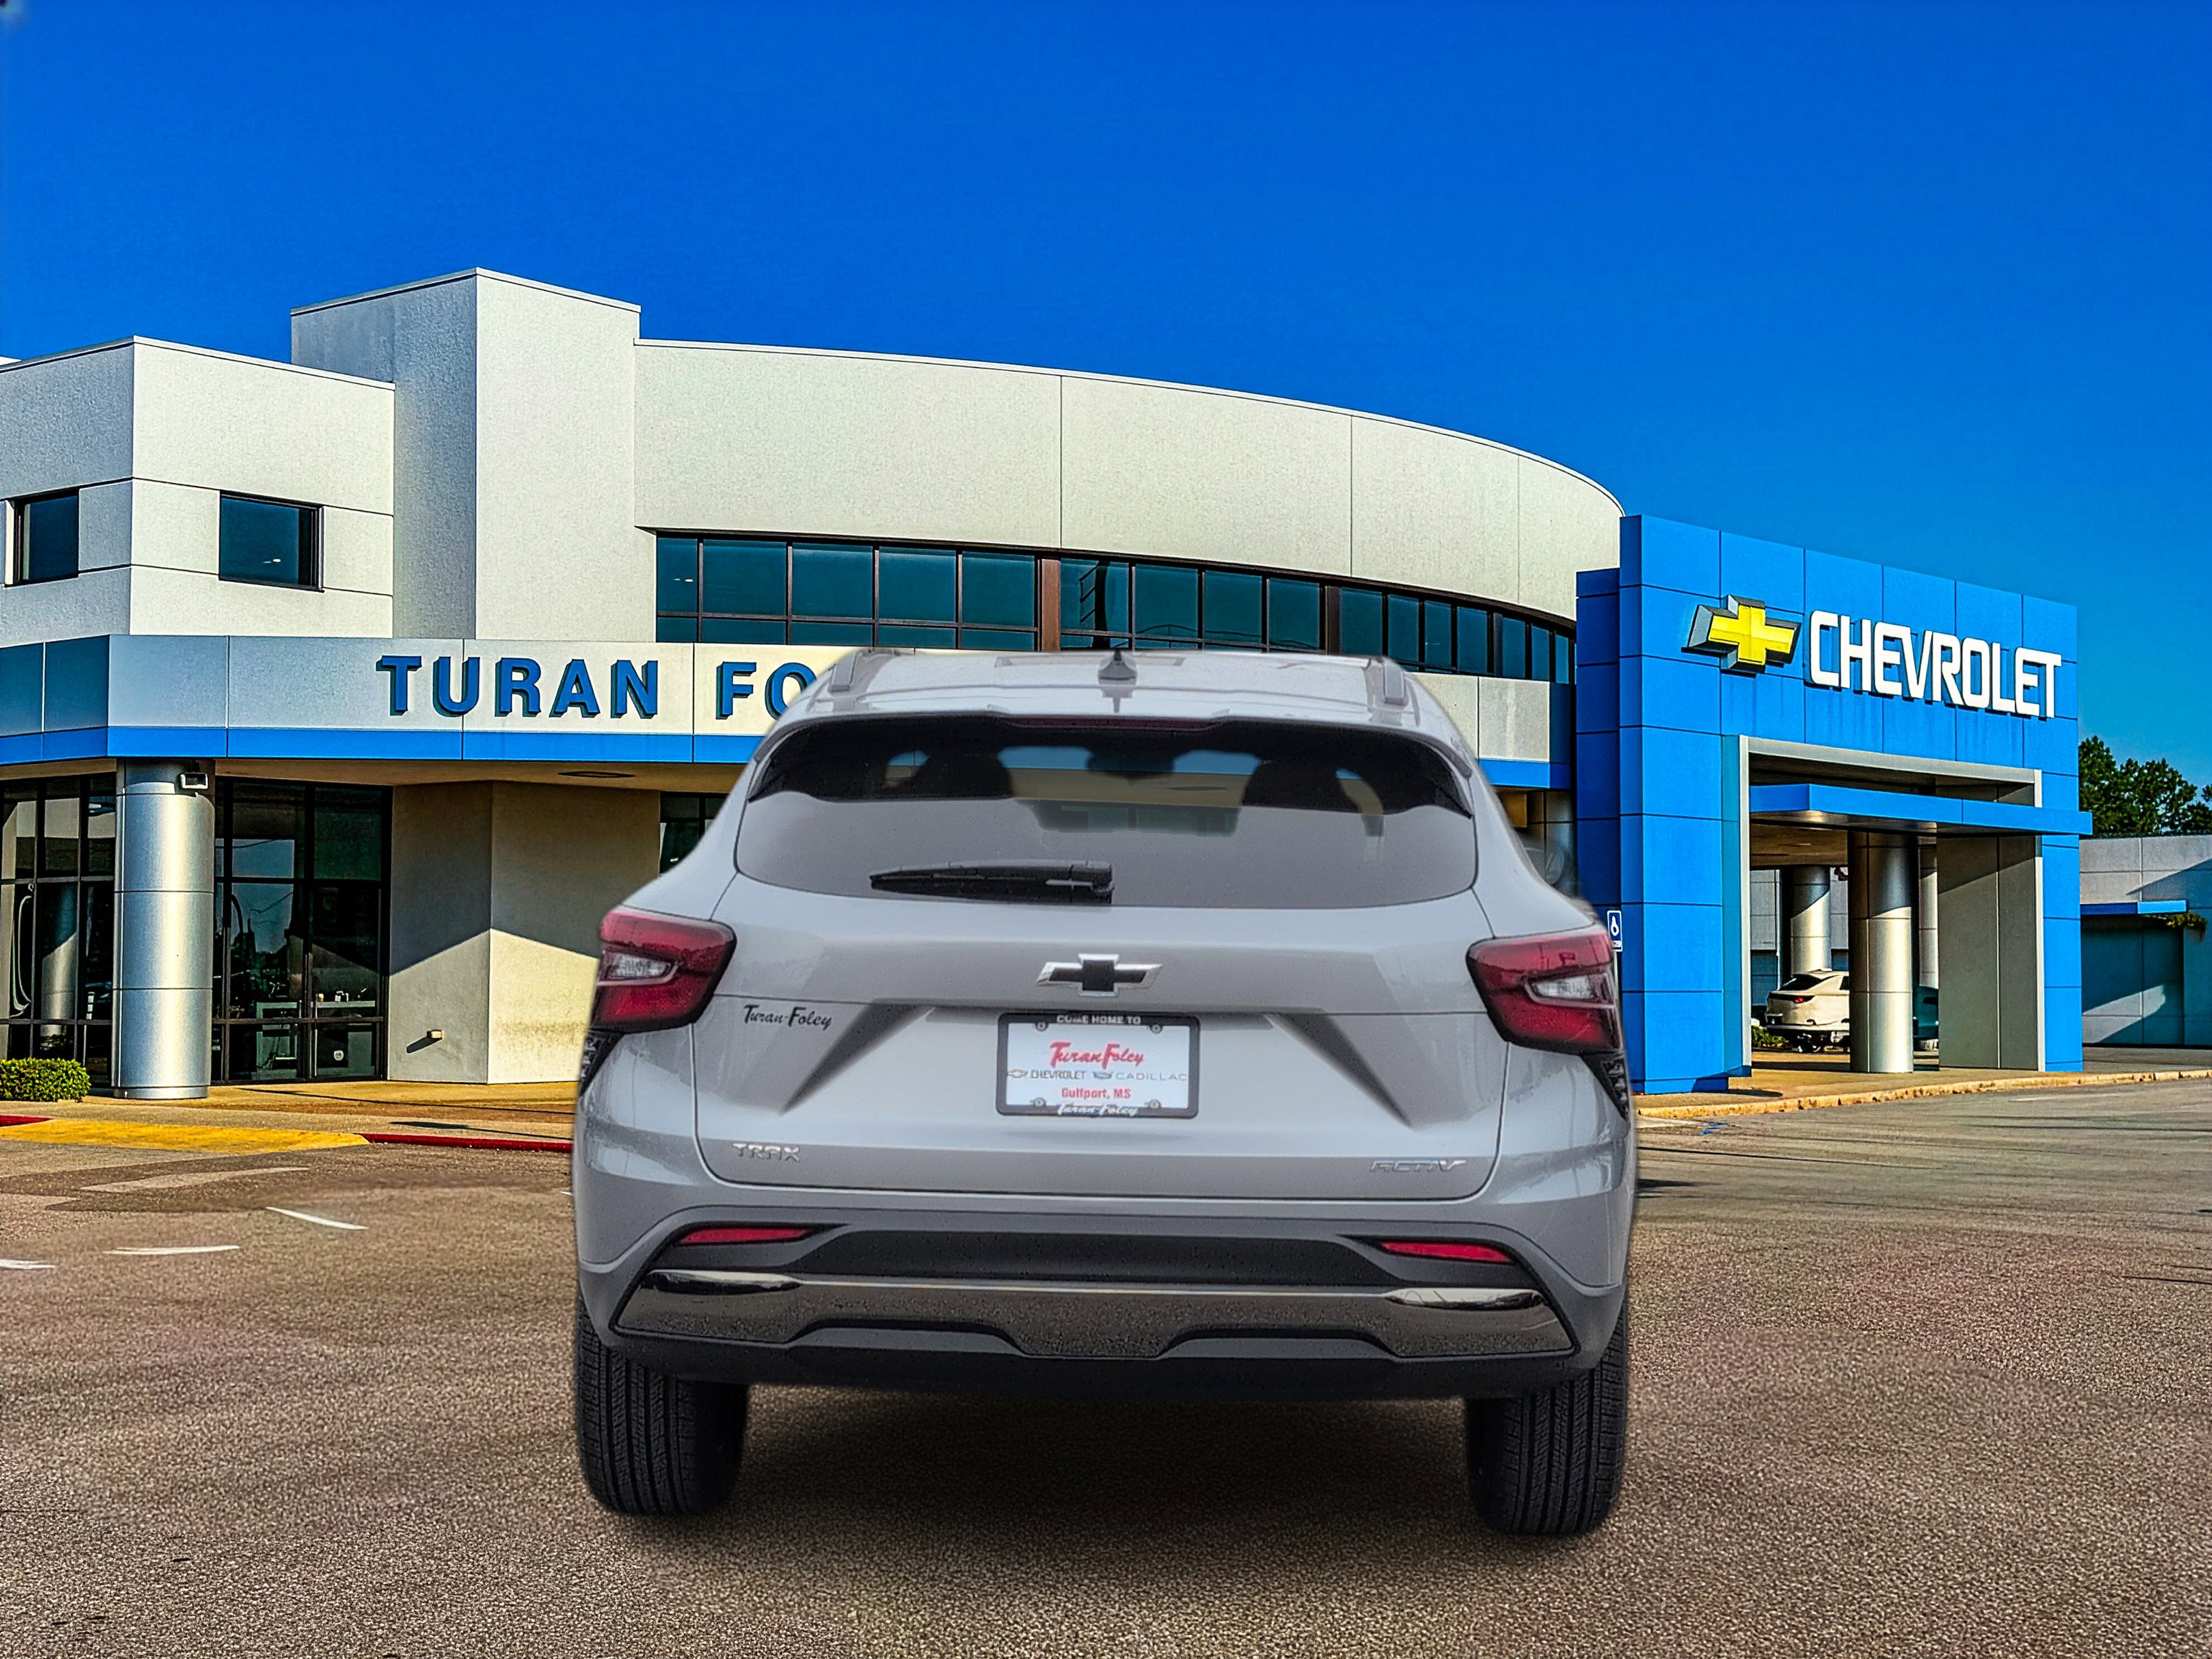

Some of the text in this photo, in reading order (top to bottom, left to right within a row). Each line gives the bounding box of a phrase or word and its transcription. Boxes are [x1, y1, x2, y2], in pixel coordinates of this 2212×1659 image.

[1810, 610, 2062, 718] CHEVROLET
[376, 655, 817, 721] TURAN FO
[1091, 1015, 1124, 1024] HOME
[1127, 1016, 1141, 1024] TO
[1031, 1069, 1187, 1082] CHEVROLET CADILLAC
[1061, 1087, 1131, 1099] Gulfport, MS
[732, 1142, 800, 1162] TRAX
